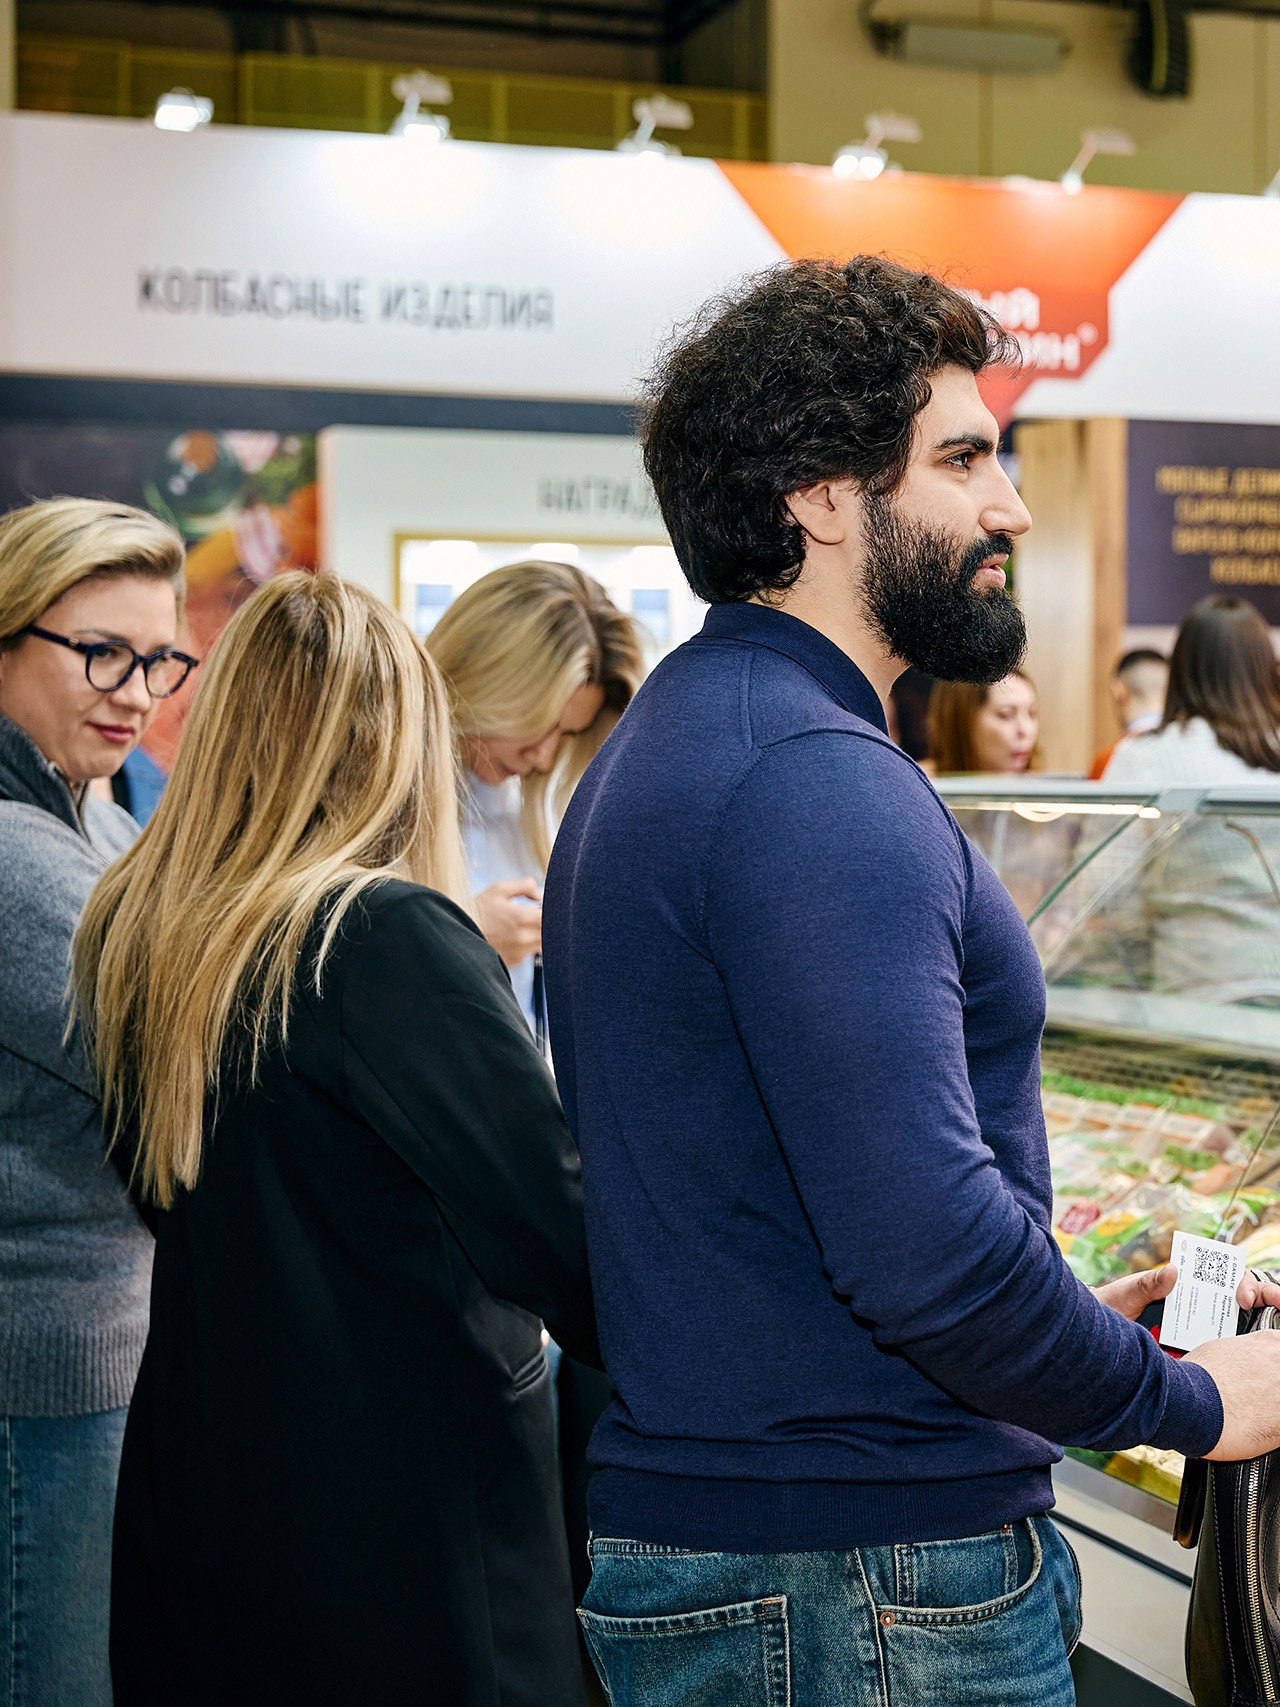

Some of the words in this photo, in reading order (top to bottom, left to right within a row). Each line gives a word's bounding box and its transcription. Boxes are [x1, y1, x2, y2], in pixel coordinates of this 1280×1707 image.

[137, 266, 368, 324] КОЛБАСНЫЕ
[381, 277, 555, 331] ИЗДЕЛИЯ
[1229, 1262, 1238, 1290] DAMATE
